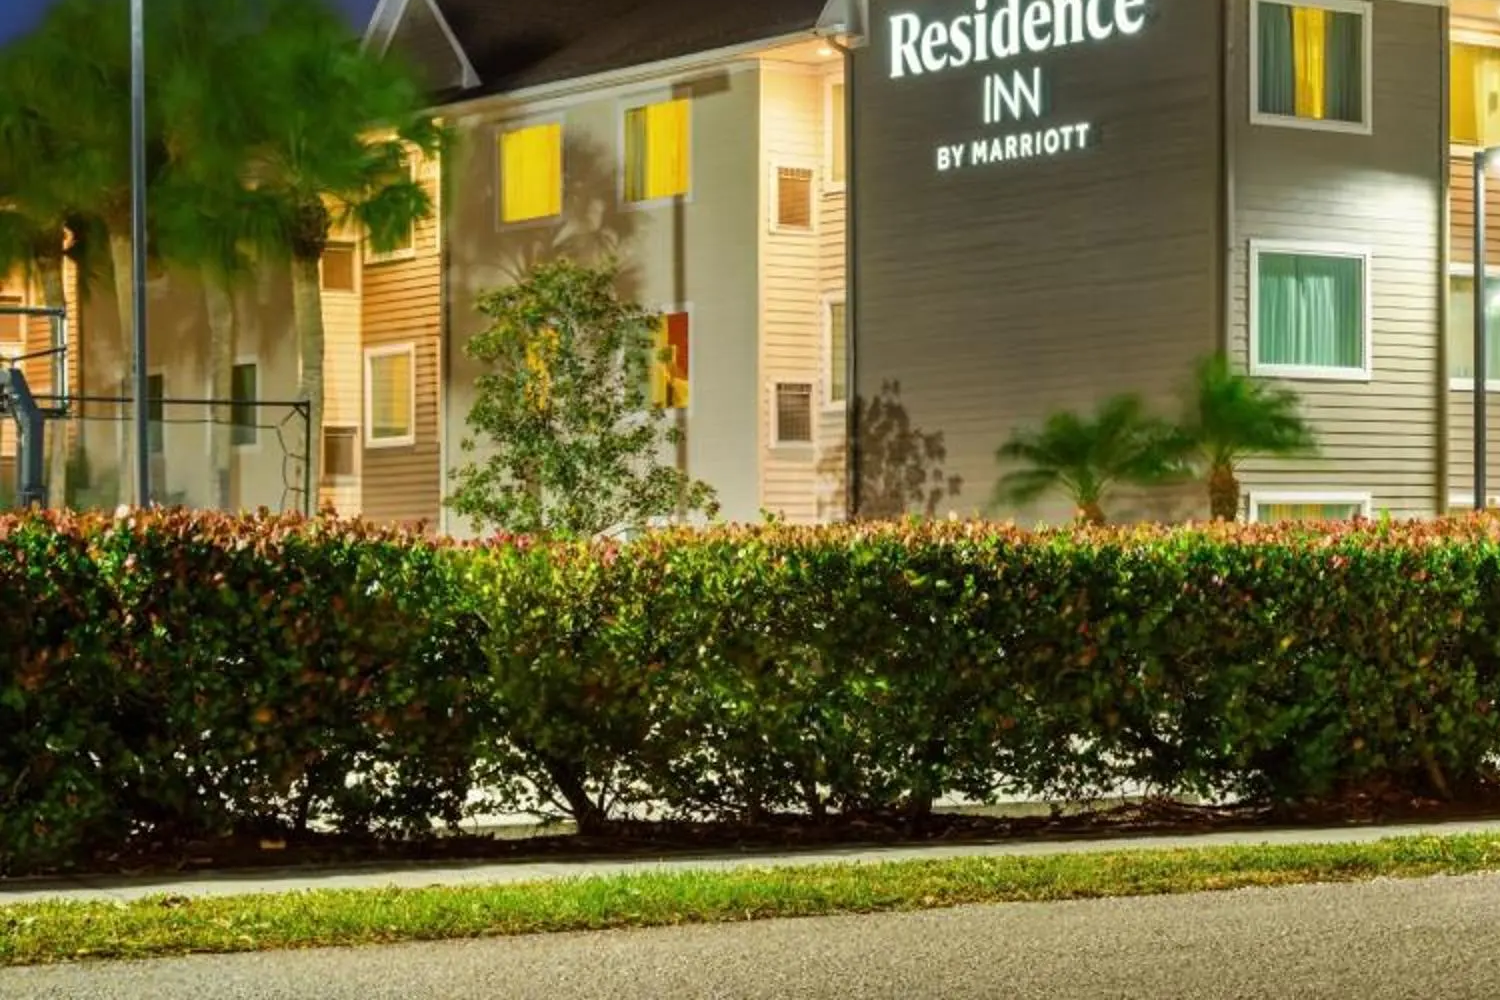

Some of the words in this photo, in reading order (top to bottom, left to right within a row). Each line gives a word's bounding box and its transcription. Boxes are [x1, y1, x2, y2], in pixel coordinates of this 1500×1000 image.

[983, 66, 1041, 124] INN
[936, 143, 965, 171] BY
[971, 122, 1090, 165] MARRIOTT
